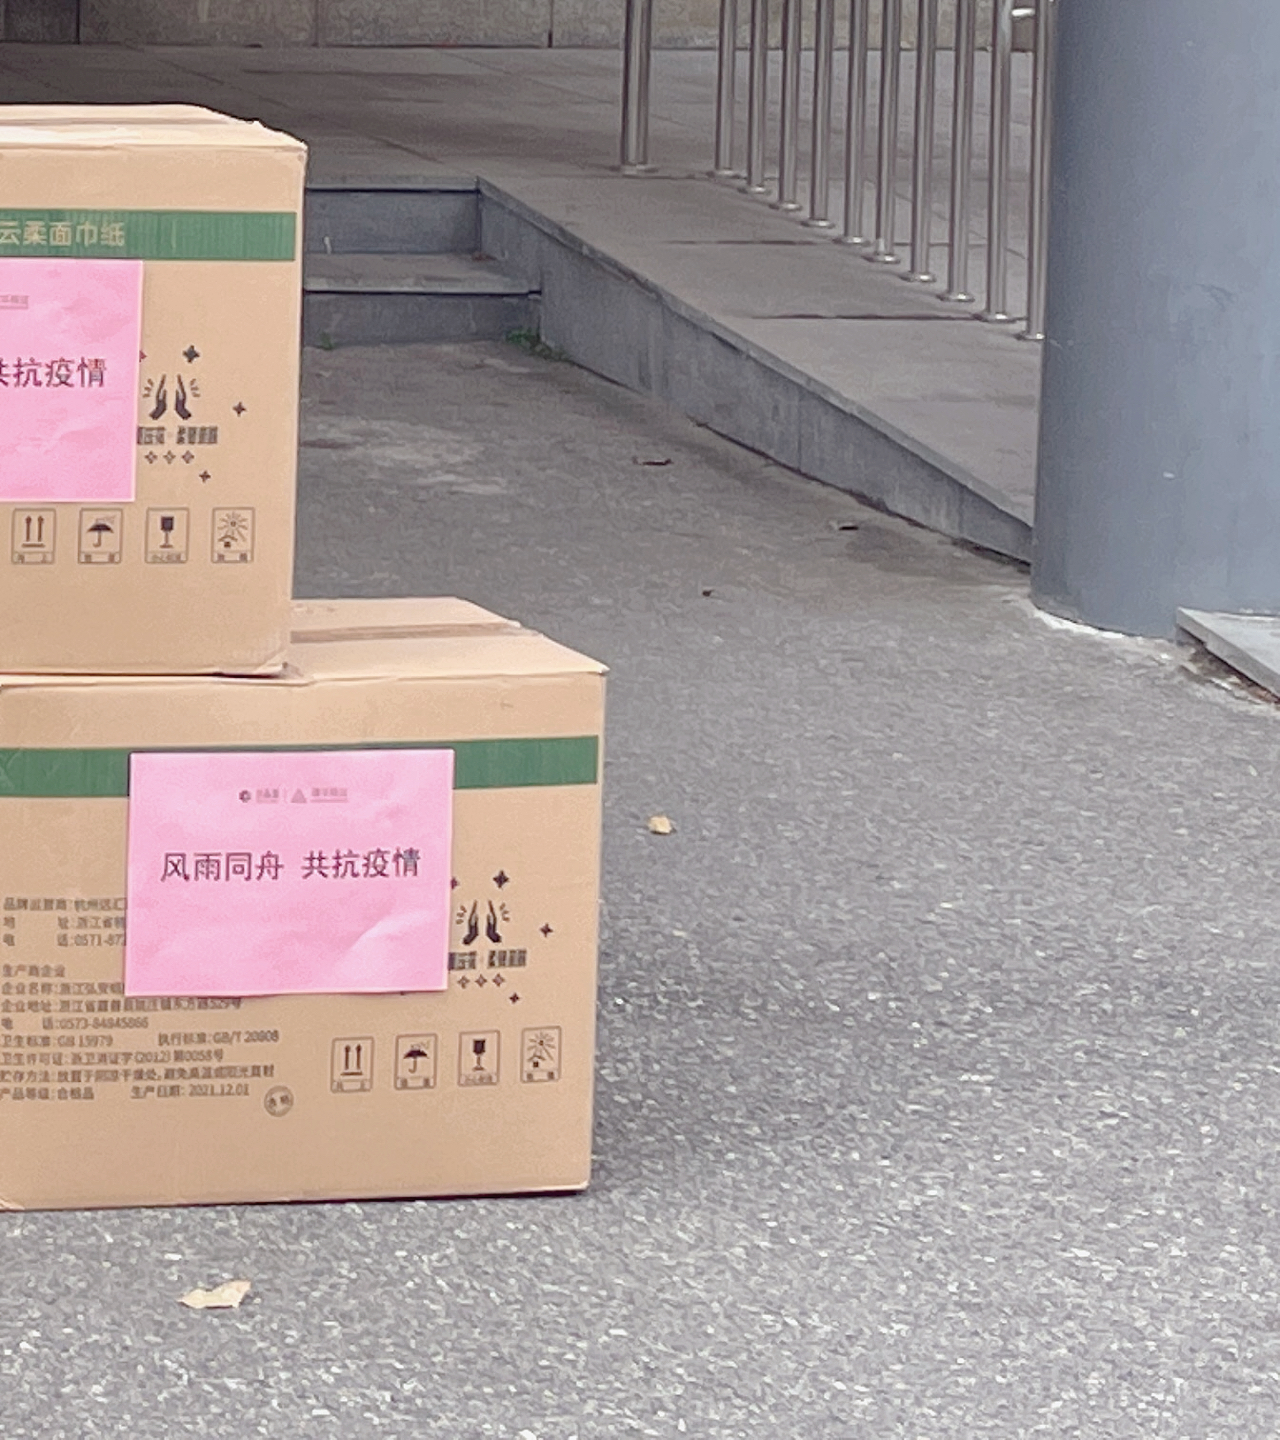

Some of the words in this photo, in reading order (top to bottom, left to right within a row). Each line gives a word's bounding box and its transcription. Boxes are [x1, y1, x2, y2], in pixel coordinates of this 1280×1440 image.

[160, 851, 285, 883] 风雨同舟
[301, 848, 420, 879] 共抗疫情
